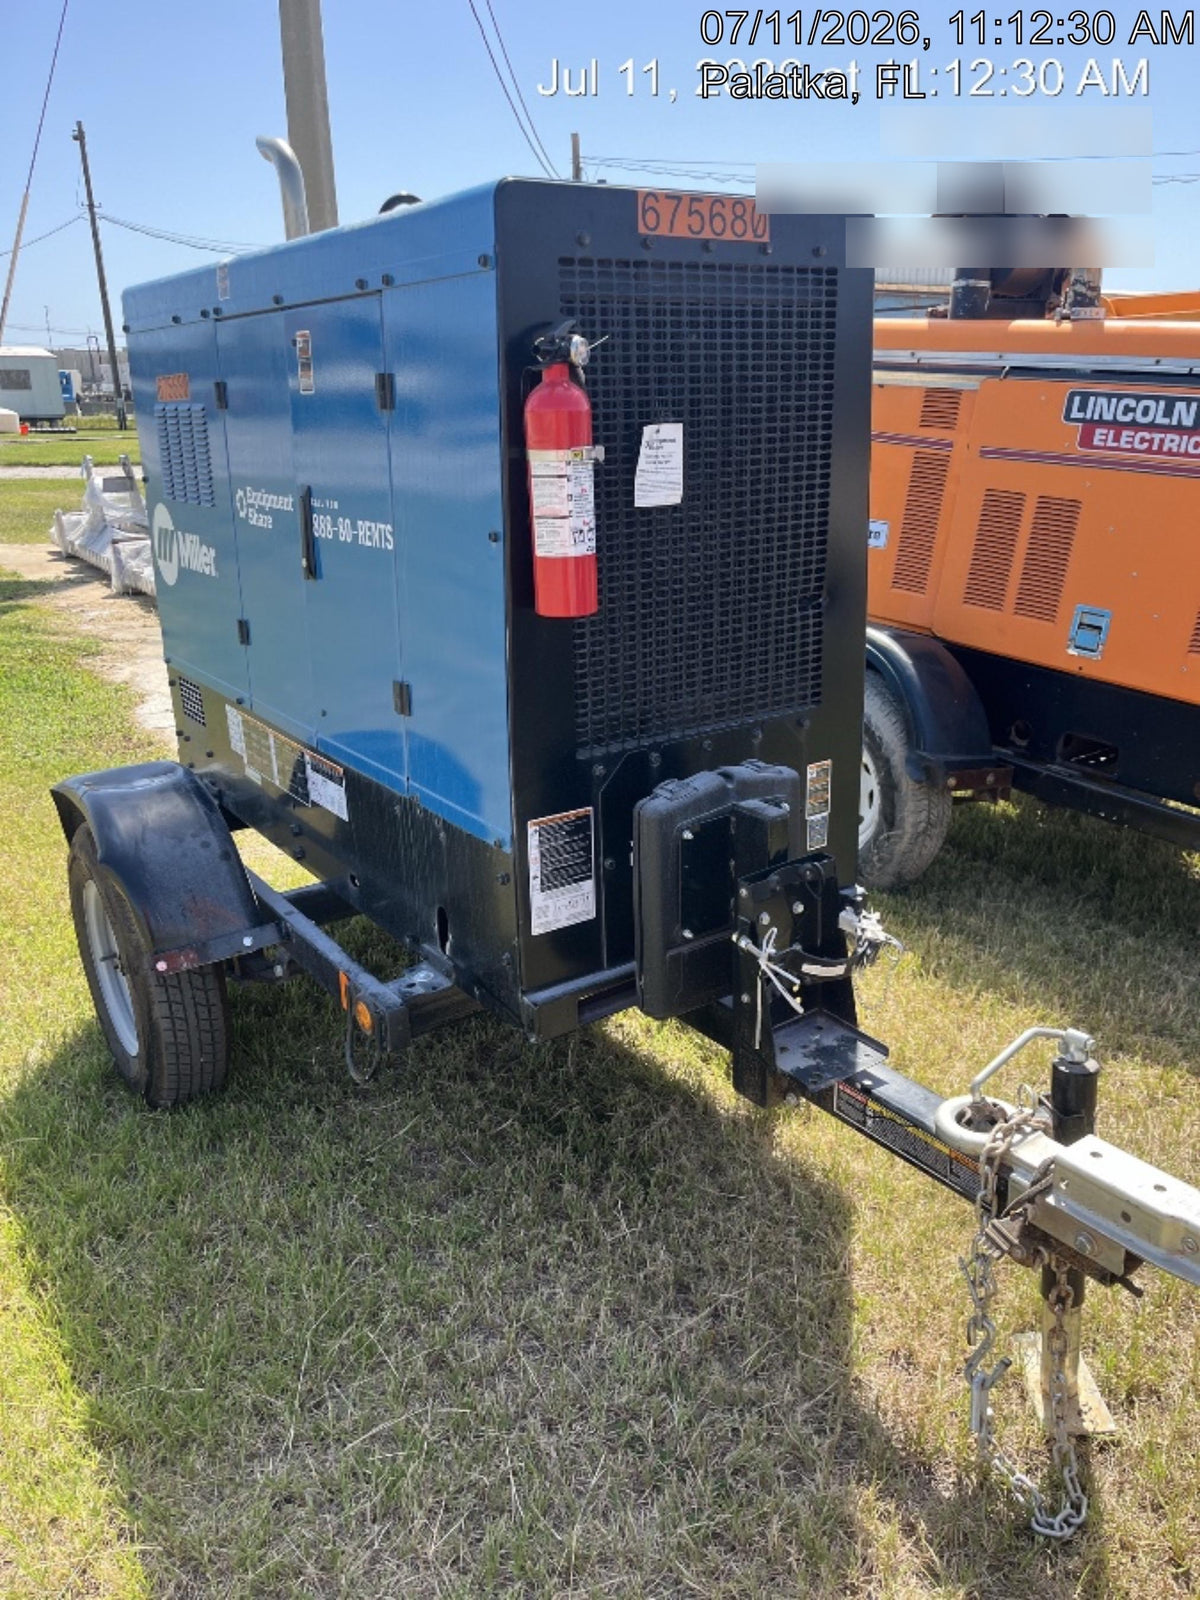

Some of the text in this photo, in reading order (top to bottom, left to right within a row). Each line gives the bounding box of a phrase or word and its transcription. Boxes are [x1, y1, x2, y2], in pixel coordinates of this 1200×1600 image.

[1070, 395, 1198, 428] LINCOLN
[1092, 428, 1200, 455] ELECTRIC
[312, 513, 394, 550] 888-80-RENTS
[177, 530, 216, 577] Miller
